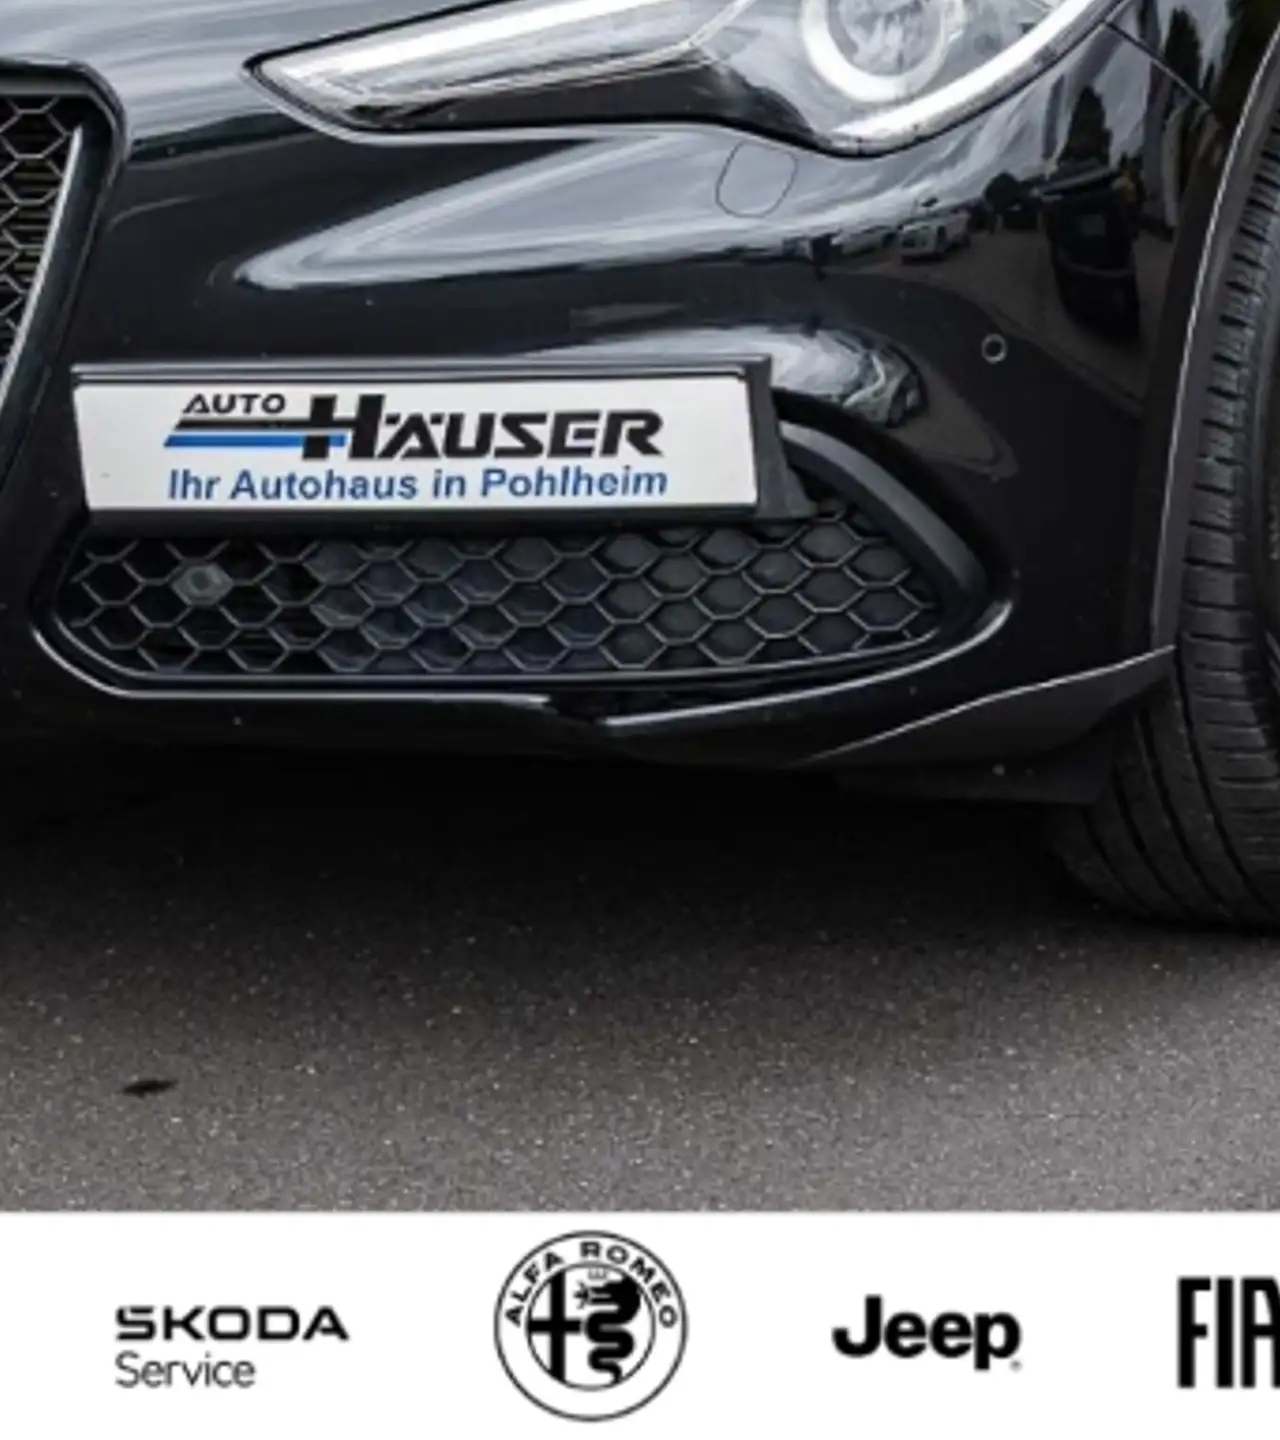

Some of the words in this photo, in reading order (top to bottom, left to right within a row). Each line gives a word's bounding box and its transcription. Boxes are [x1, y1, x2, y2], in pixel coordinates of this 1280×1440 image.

[181, 392, 286, 416] AUTO
[301, 393, 664, 459] HÄUSER
[167, 468, 221, 501] Ihr
[230, 467, 418, 501] Autohaus
[431, 467, 466, 498] in
[481, 467, 668, 498] Pohlheim
